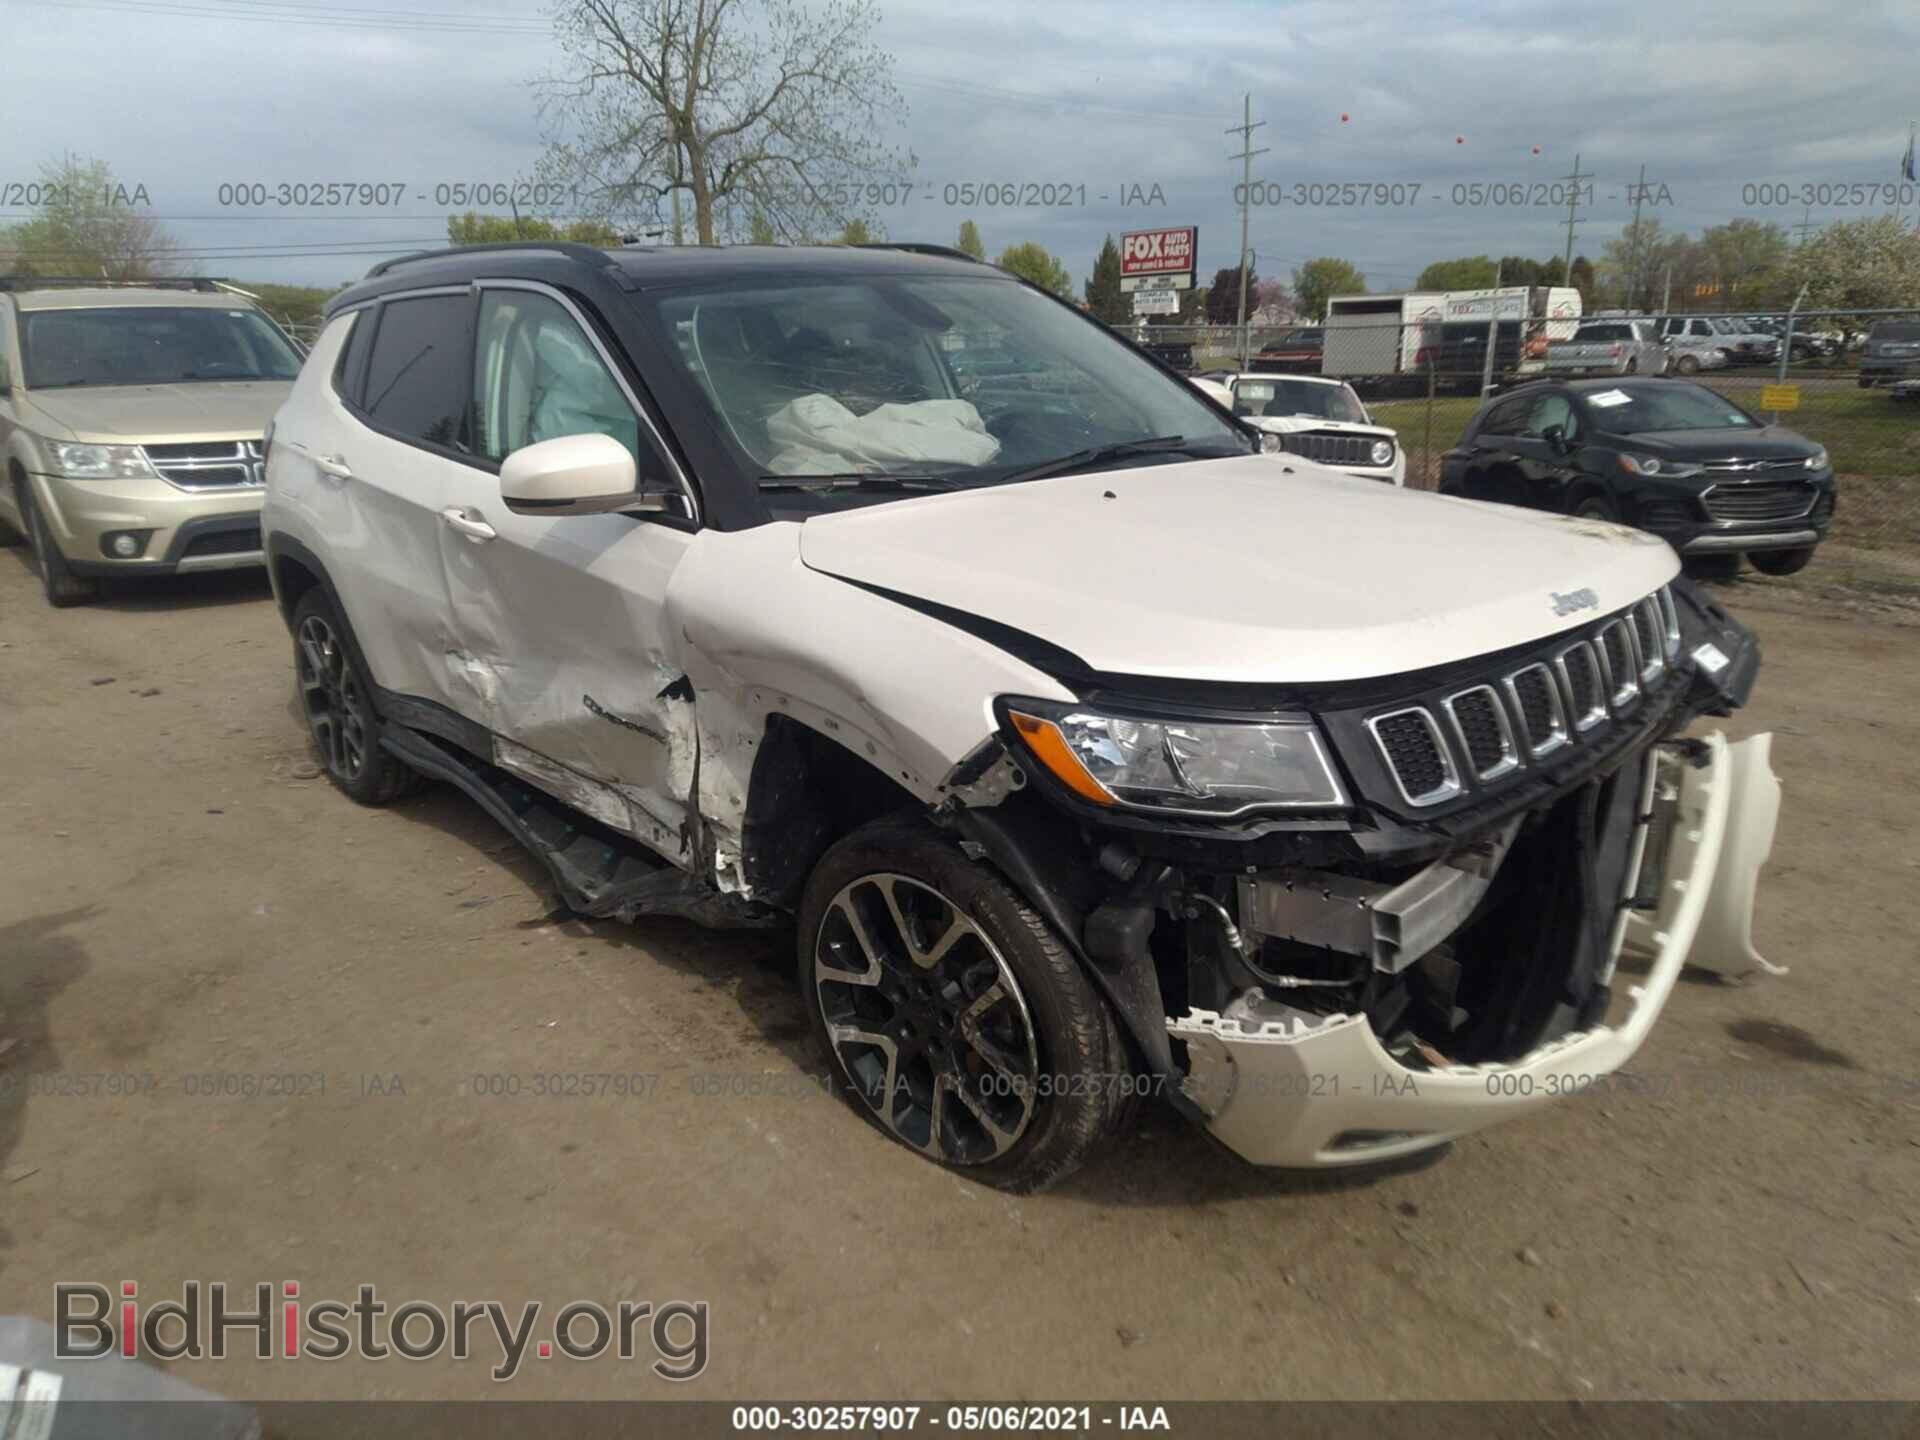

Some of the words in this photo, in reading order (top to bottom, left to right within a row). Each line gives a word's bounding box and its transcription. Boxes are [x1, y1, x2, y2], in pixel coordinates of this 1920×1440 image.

[1124, 233, 1163, 260] FOX
[1165, 232, 1188, 244] AUTO
[1164, 243, 1190, 256] PARTS
